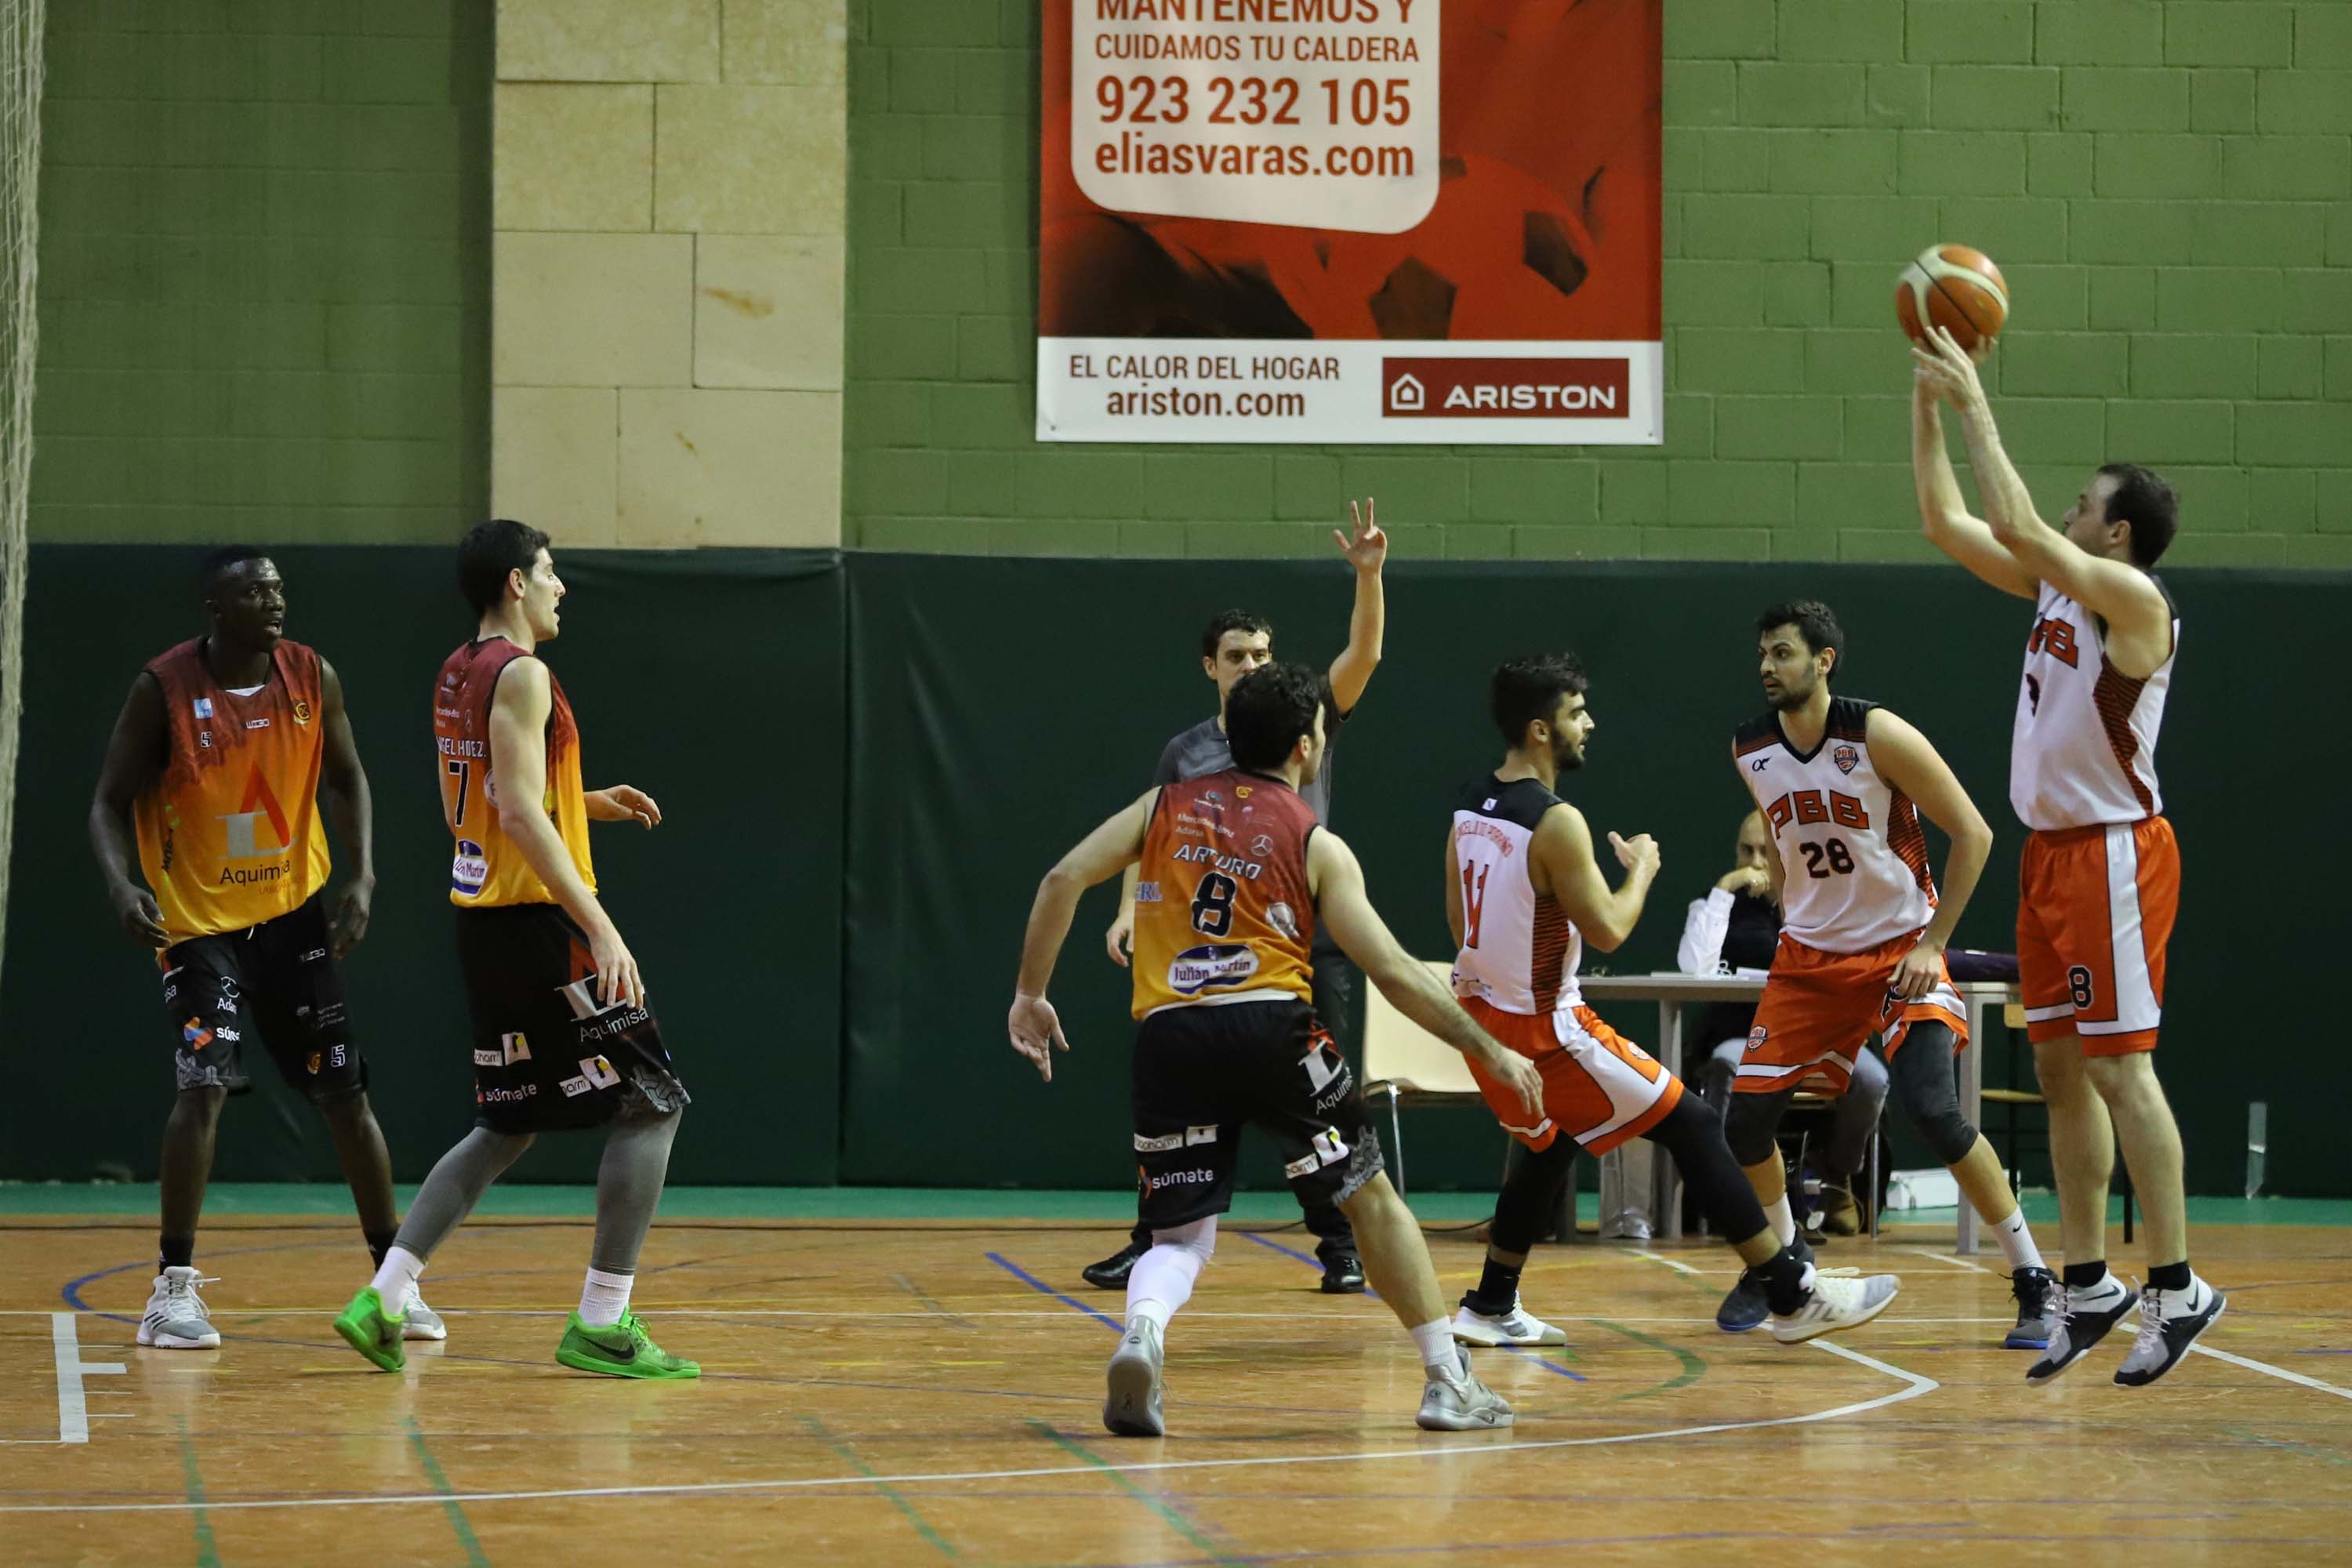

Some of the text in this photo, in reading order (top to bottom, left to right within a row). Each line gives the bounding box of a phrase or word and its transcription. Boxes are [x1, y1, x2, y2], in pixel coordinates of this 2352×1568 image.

[1097, 0, 1413, 23] MANTENEMOS Y
[1095, 34, 1419, 62] CUIDAMOS TU CALDERA
[1097, 75, 1410, 126] 923 232 105
[1095, 131, 1413, 176] eliasvaras.com
[1069, 356, 1340, 380] EL CALOR DEL HOGAR
[1106, 382, 1305, 417] ariston.com
[1444, 384, 1615, 409] ARISTON
[201, 731, 212, 749] 5
[448, 759, 468, 828] 7
[1766, 789, 1870, 840] PBB
[1173, 844, 1261, 880] ARTURO
[1799, 837, 1855, 880] 28
[1190, 870, 1237, 938] 8
[2067, 965, 2094, 1010] 8
[580, 1007, 650, 1043] Aquimisa
[331, 1044, 346, 1067] 5
[485, 1083, 537, 1102] súmate
[1152, 1167, 1214, 1189] súmate
